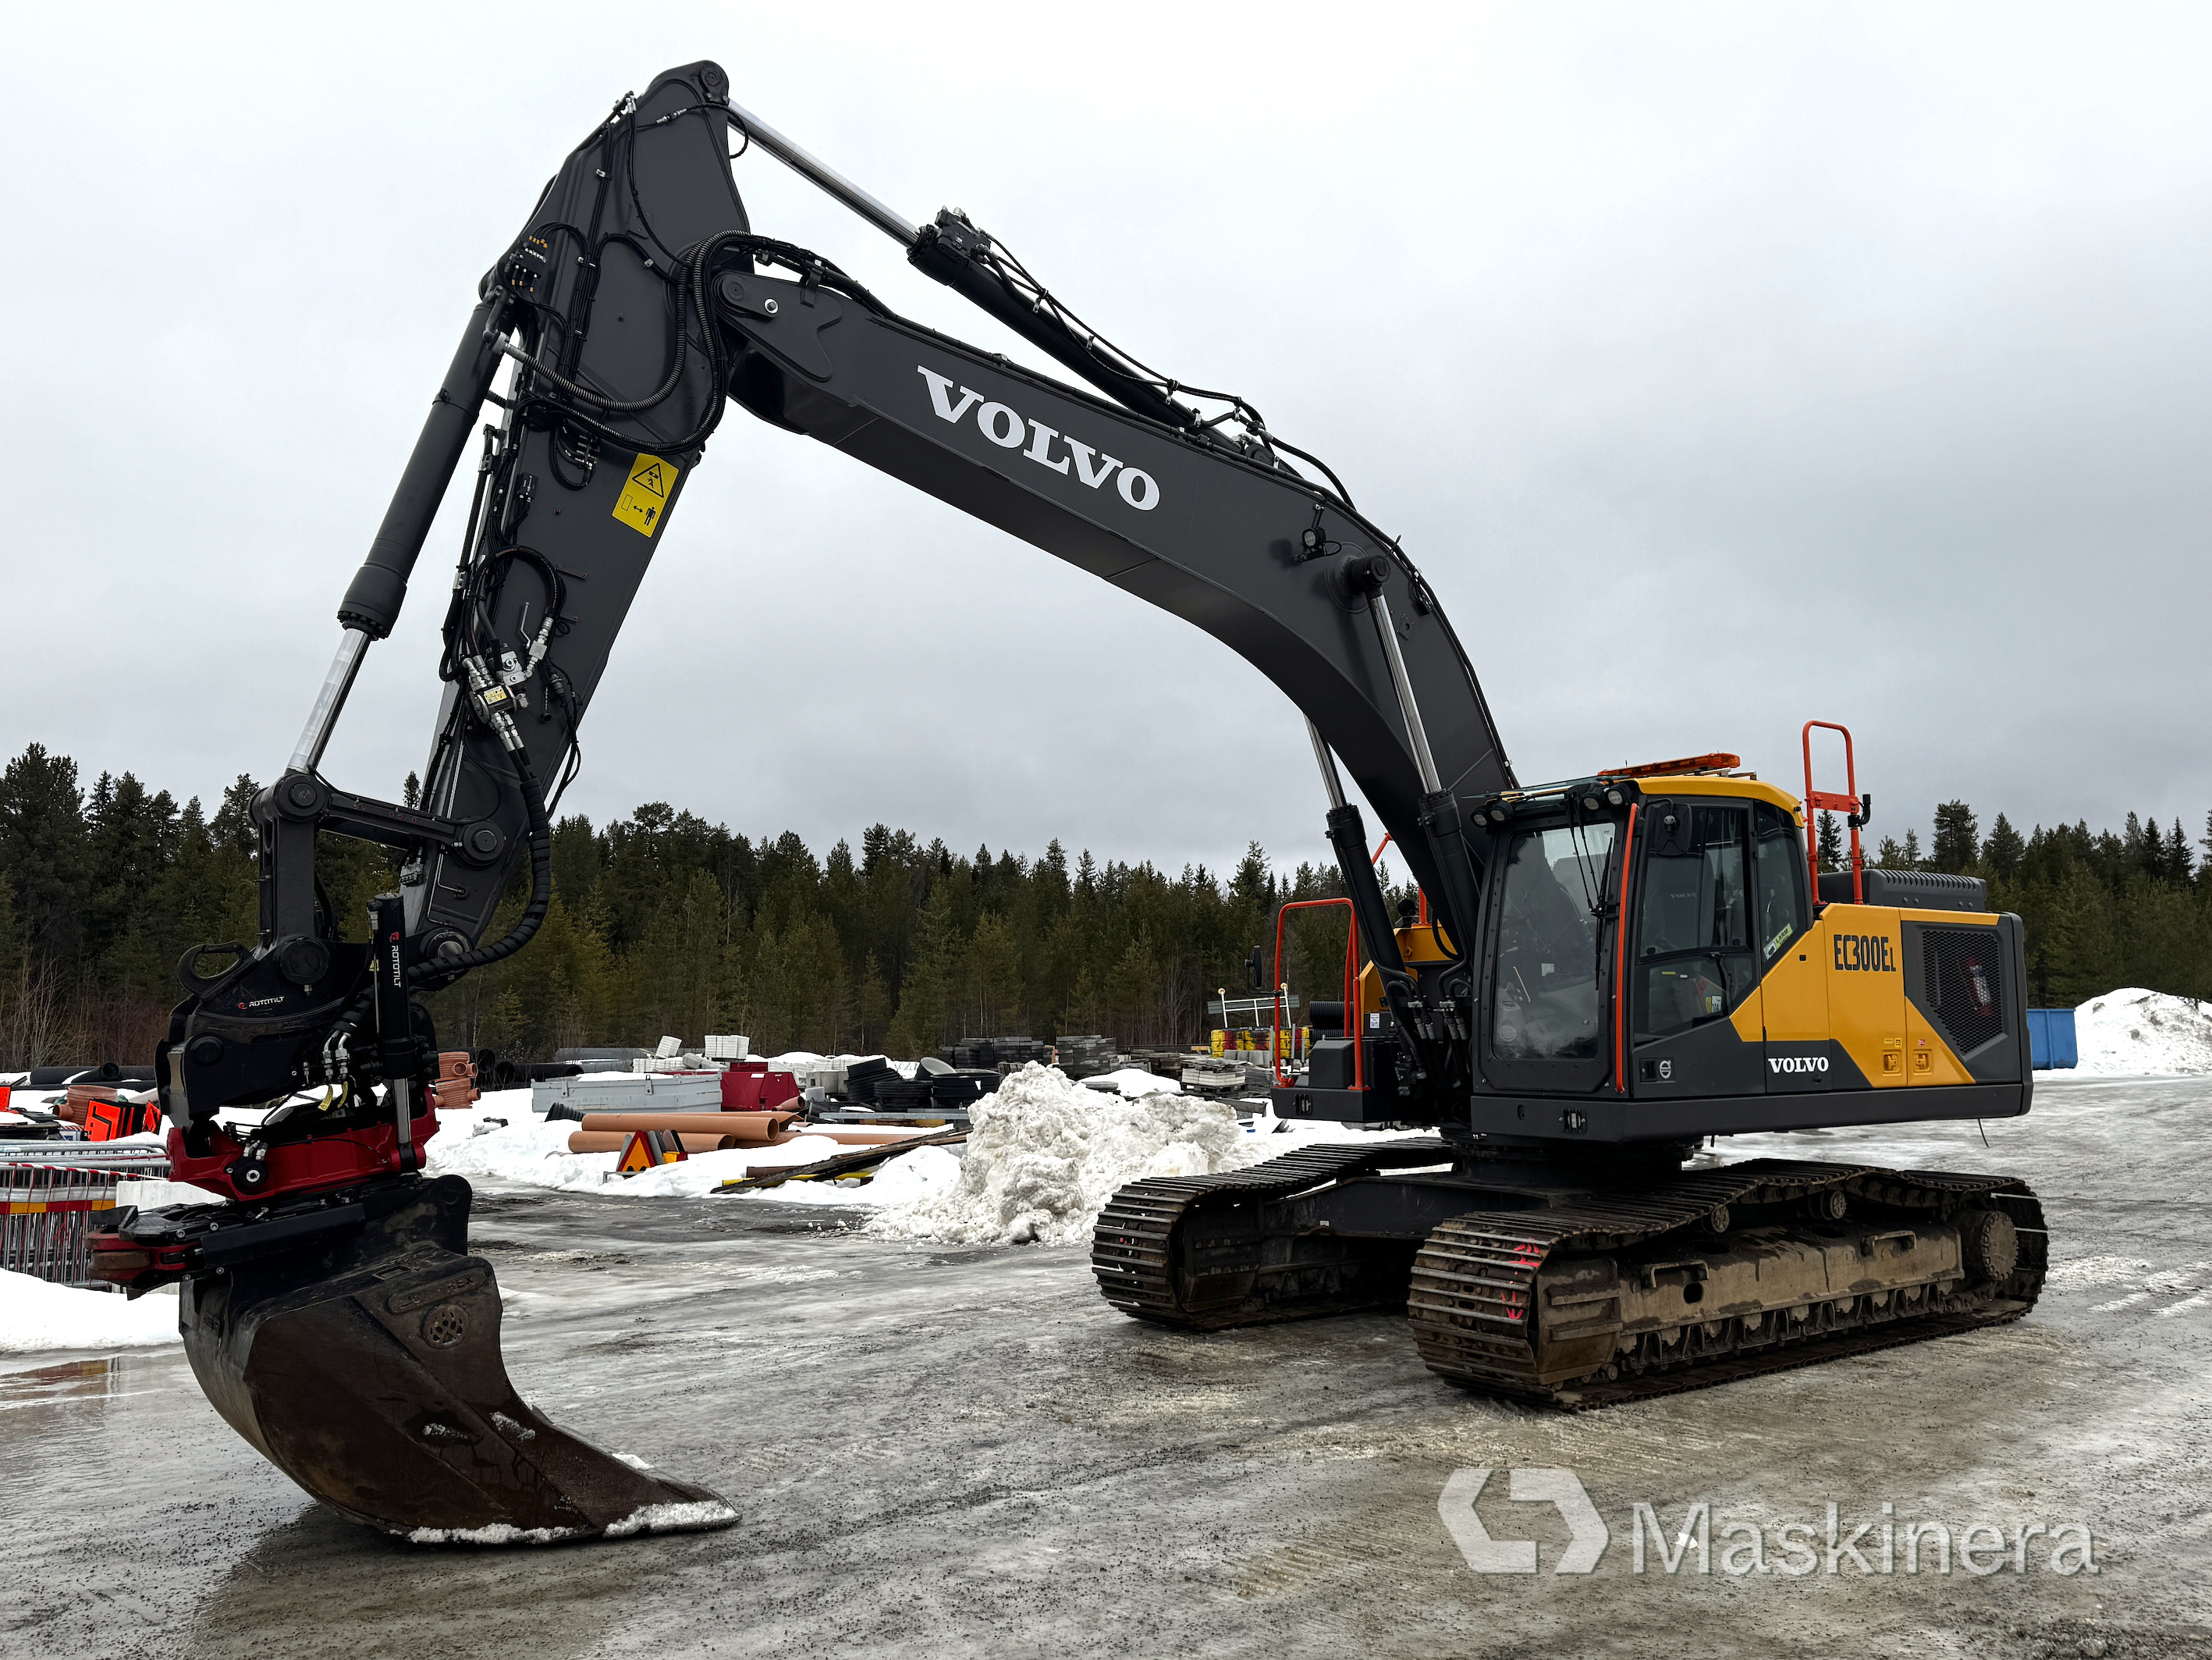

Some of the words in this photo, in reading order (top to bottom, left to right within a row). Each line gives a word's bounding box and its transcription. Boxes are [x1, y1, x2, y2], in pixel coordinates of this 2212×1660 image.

[917, 364, 1160, 511] VOLVO
[1775, 928, 1788, 943] LARM
[391, 945, 401, 987] ROTOTILT
[249, 996, 285, 1007] ROTOTILT
[1768, 1057, 1829, 1073] VOLVO
